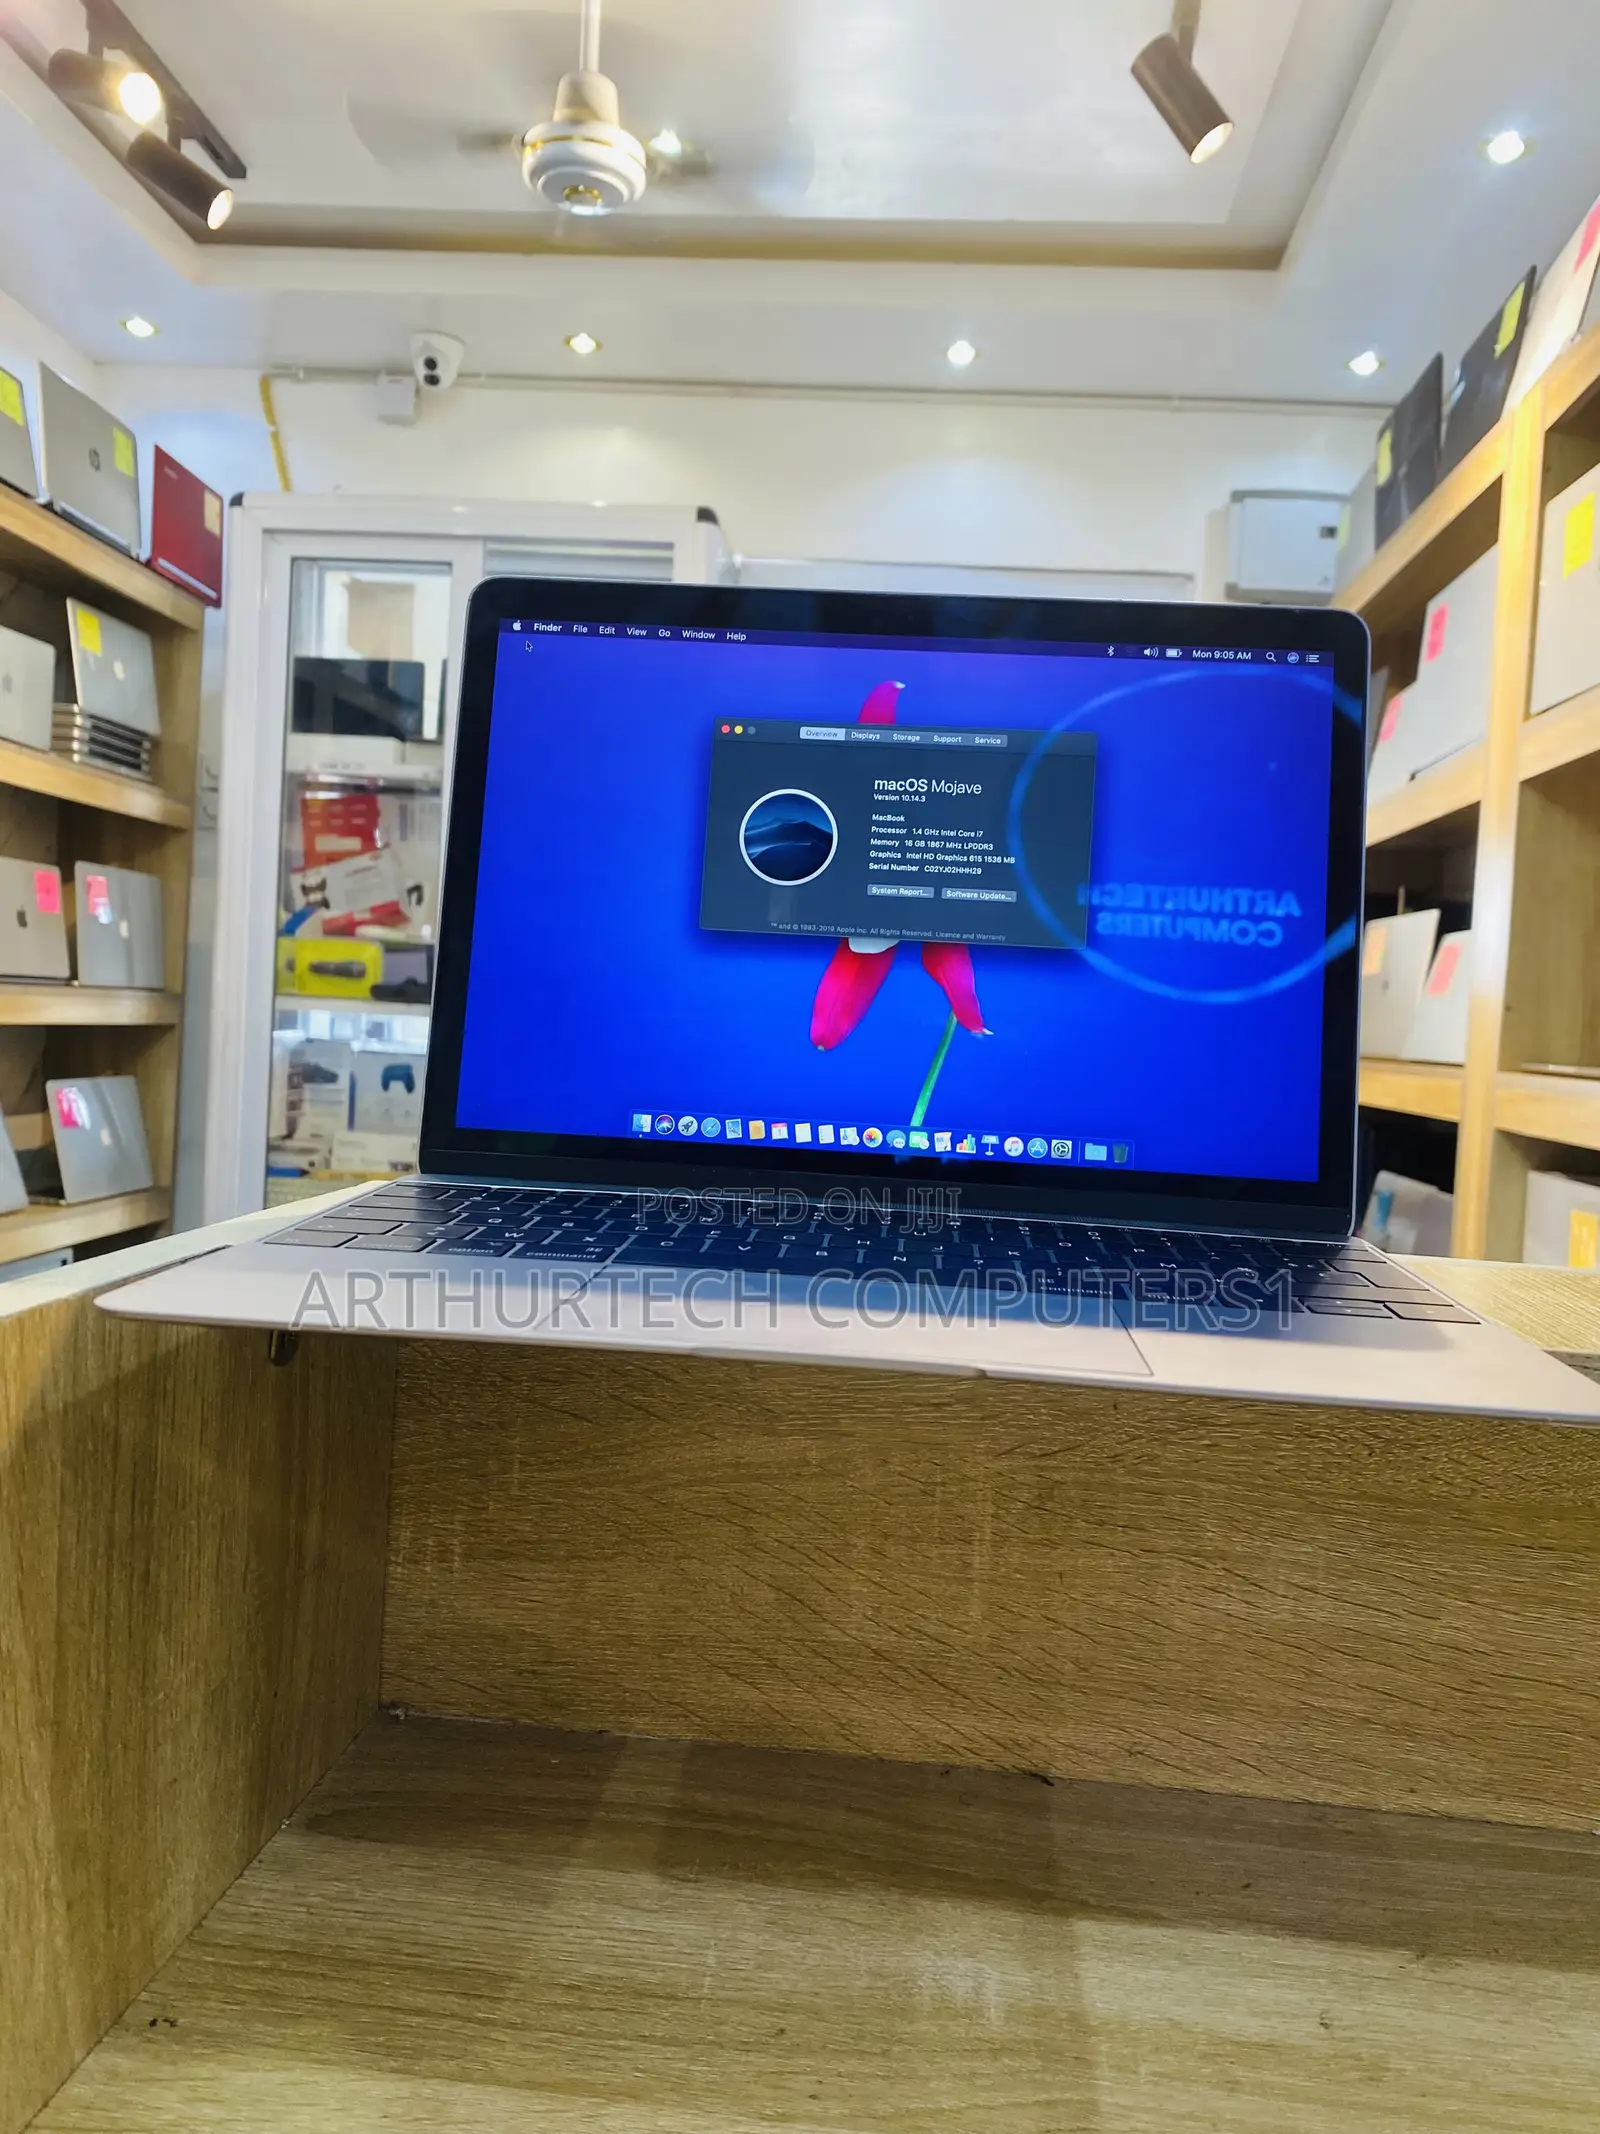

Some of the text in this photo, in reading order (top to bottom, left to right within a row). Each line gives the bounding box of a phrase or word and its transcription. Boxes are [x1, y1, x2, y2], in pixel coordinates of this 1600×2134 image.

[533, 623, 746, 642] Finder File Edit View Go Window Help
[1192, 650, 1252, 660] Mon 9:05 AM
[806, 730, 1001, 745] Overview Displays Storage Support Service
[874, 778, 982, 796] macOS Mojave
[873, 793, 926, 802] Version 10.14.3
[872, 814, 905, 822] MacBook
[871, 826, 907, 835] Processor
[924, 828, 940, 836] GHz
[941, 829, 957, 837] Intel
[870, 838, 899, 847] Memory
[963, 842, 993, 850] LPDDR3
[869, 850, 901, 860] Graphics
[923, 852, 934, 860] HD
[936, 853, 968, 863] Graphics
[984, 855, 1002, 863] 1536
[1004, 856, 1016, 864] MB
[869, 863, 889, 871] Serial
[890, 863, 919, 872] Number
[871, 887, 897, 896] System
[946, 890, 977, 899] Software
[836, 926, 855, 934] Apple
[880, 928, 900, 937] Rights
[976, 933, 1006, 942] Warranty
[526, 1251, 597, 1259] command
